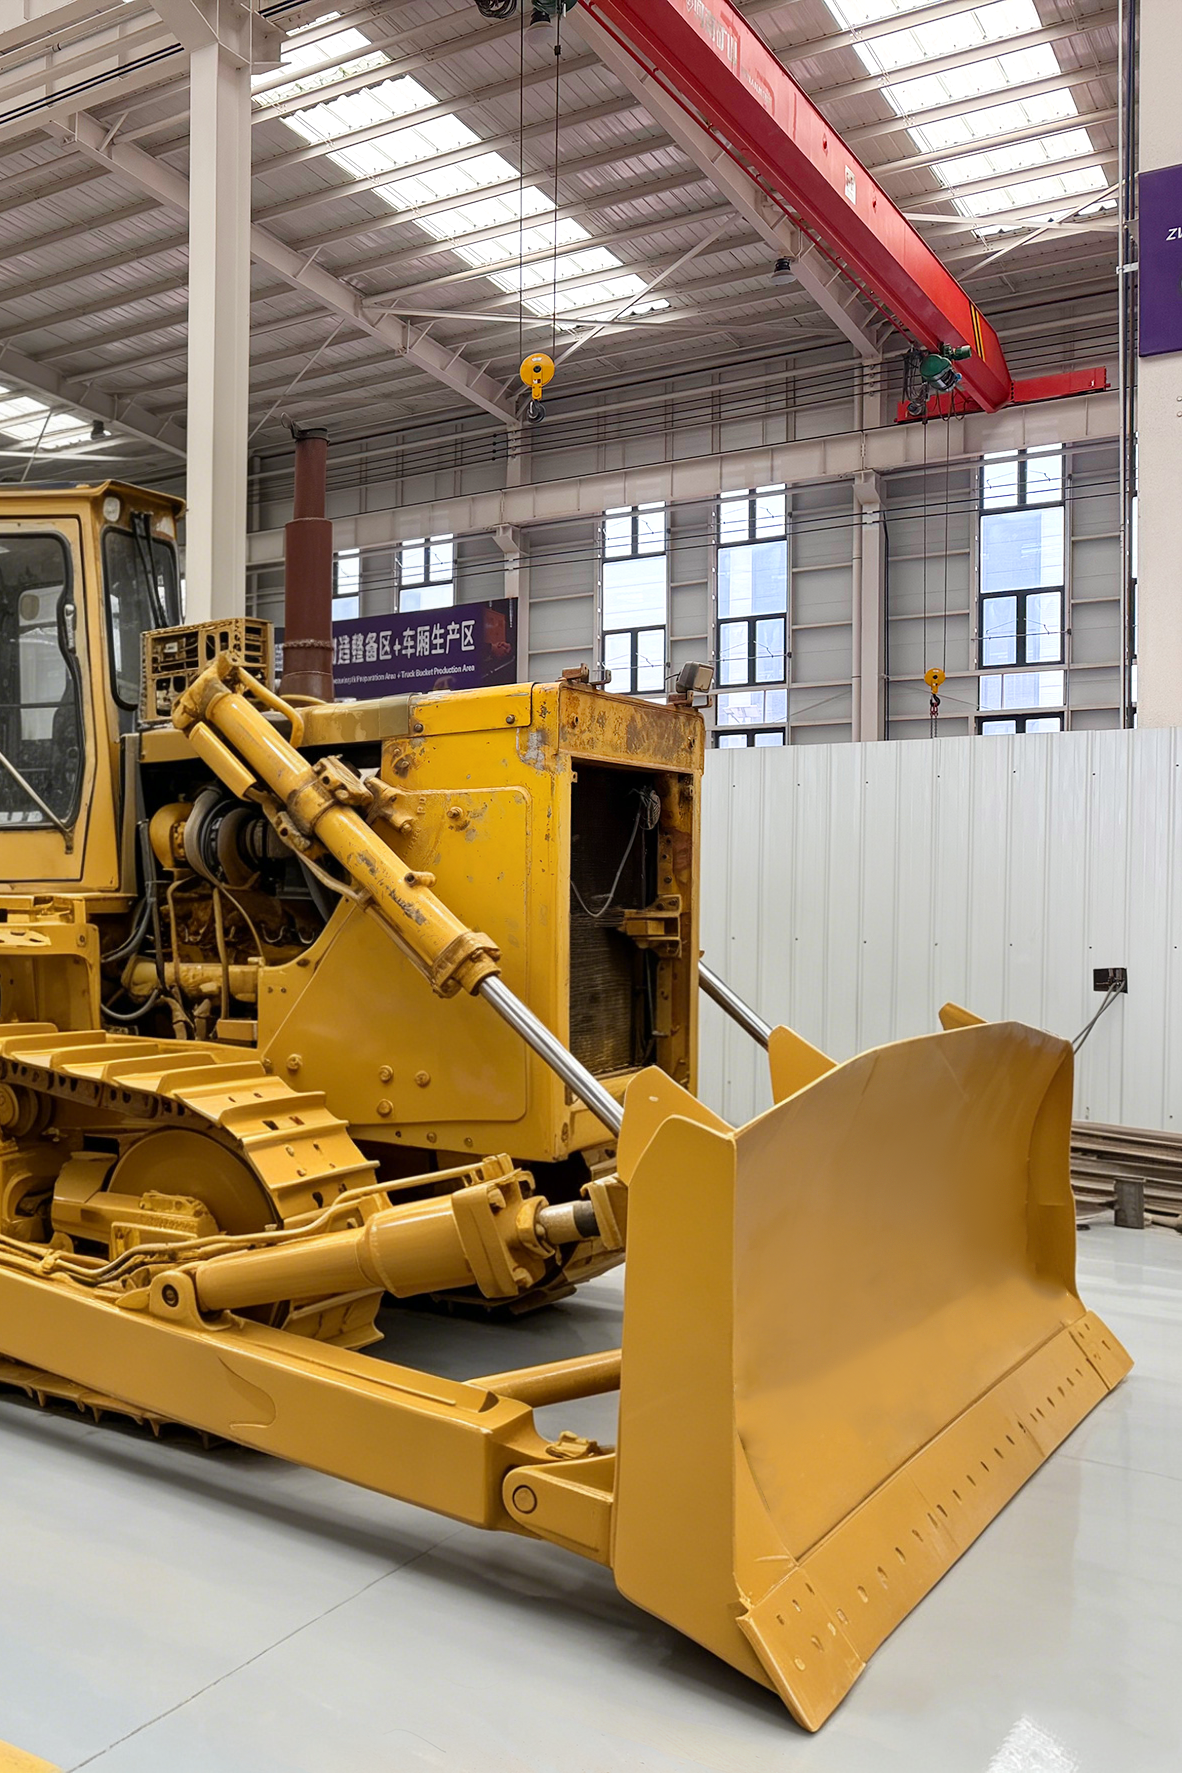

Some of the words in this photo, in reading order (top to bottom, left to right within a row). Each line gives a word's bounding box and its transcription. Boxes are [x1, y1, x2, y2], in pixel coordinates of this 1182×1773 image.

[385, 671, 396, 681] Area
[401, 670, 415, 679] Truck
[416, 668, 433, 678] Bucket
[434, 665, 461, 675] Production
[462, 663, 475, 672] Area
